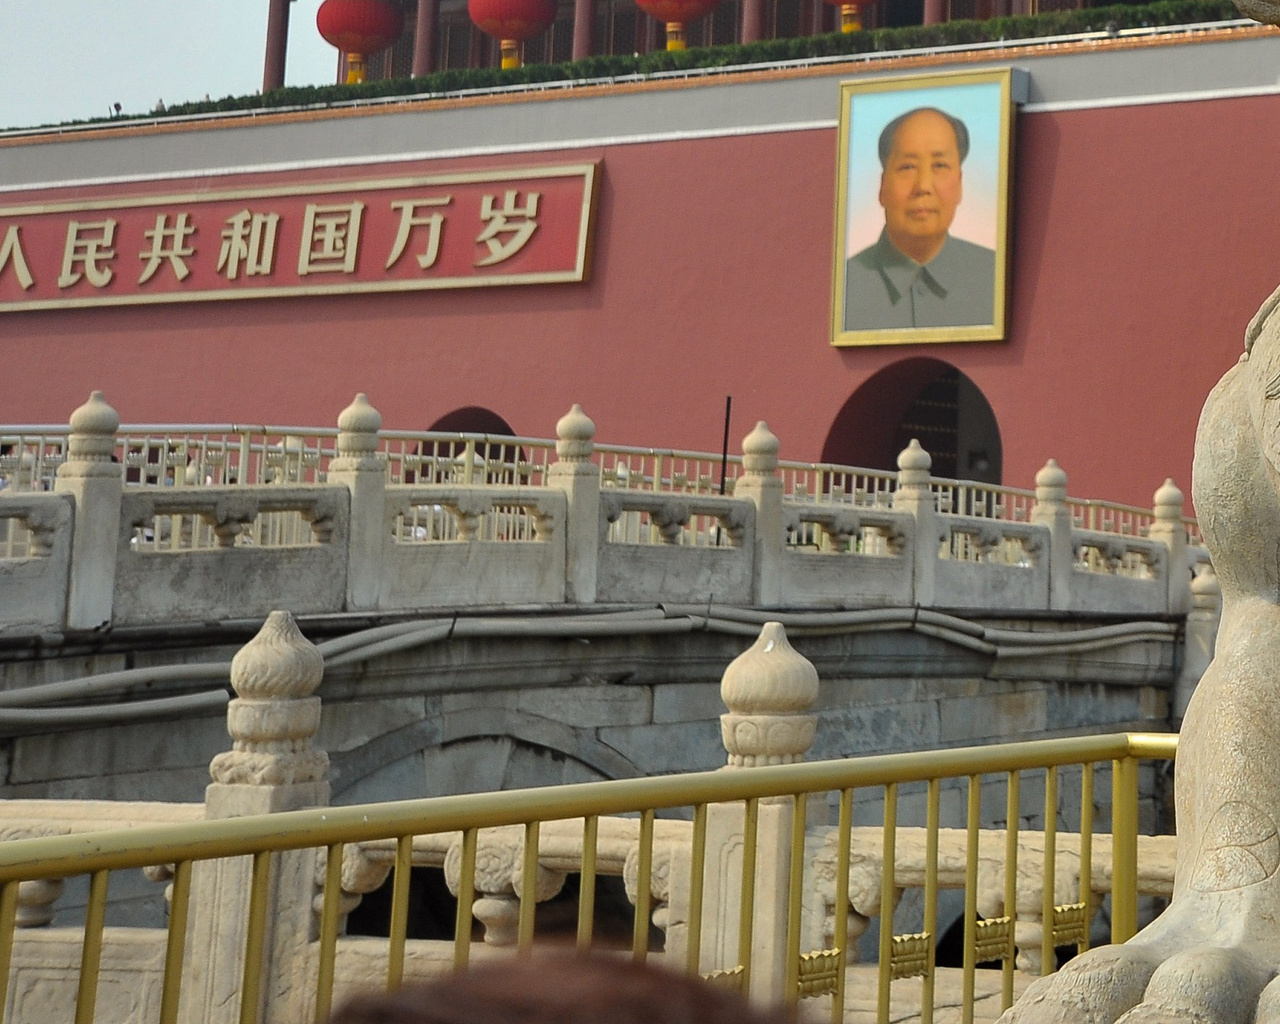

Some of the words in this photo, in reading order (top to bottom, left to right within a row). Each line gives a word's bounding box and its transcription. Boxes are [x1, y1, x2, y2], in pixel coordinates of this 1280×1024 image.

[0, 190, 542, 290] 人民共和国万岁
